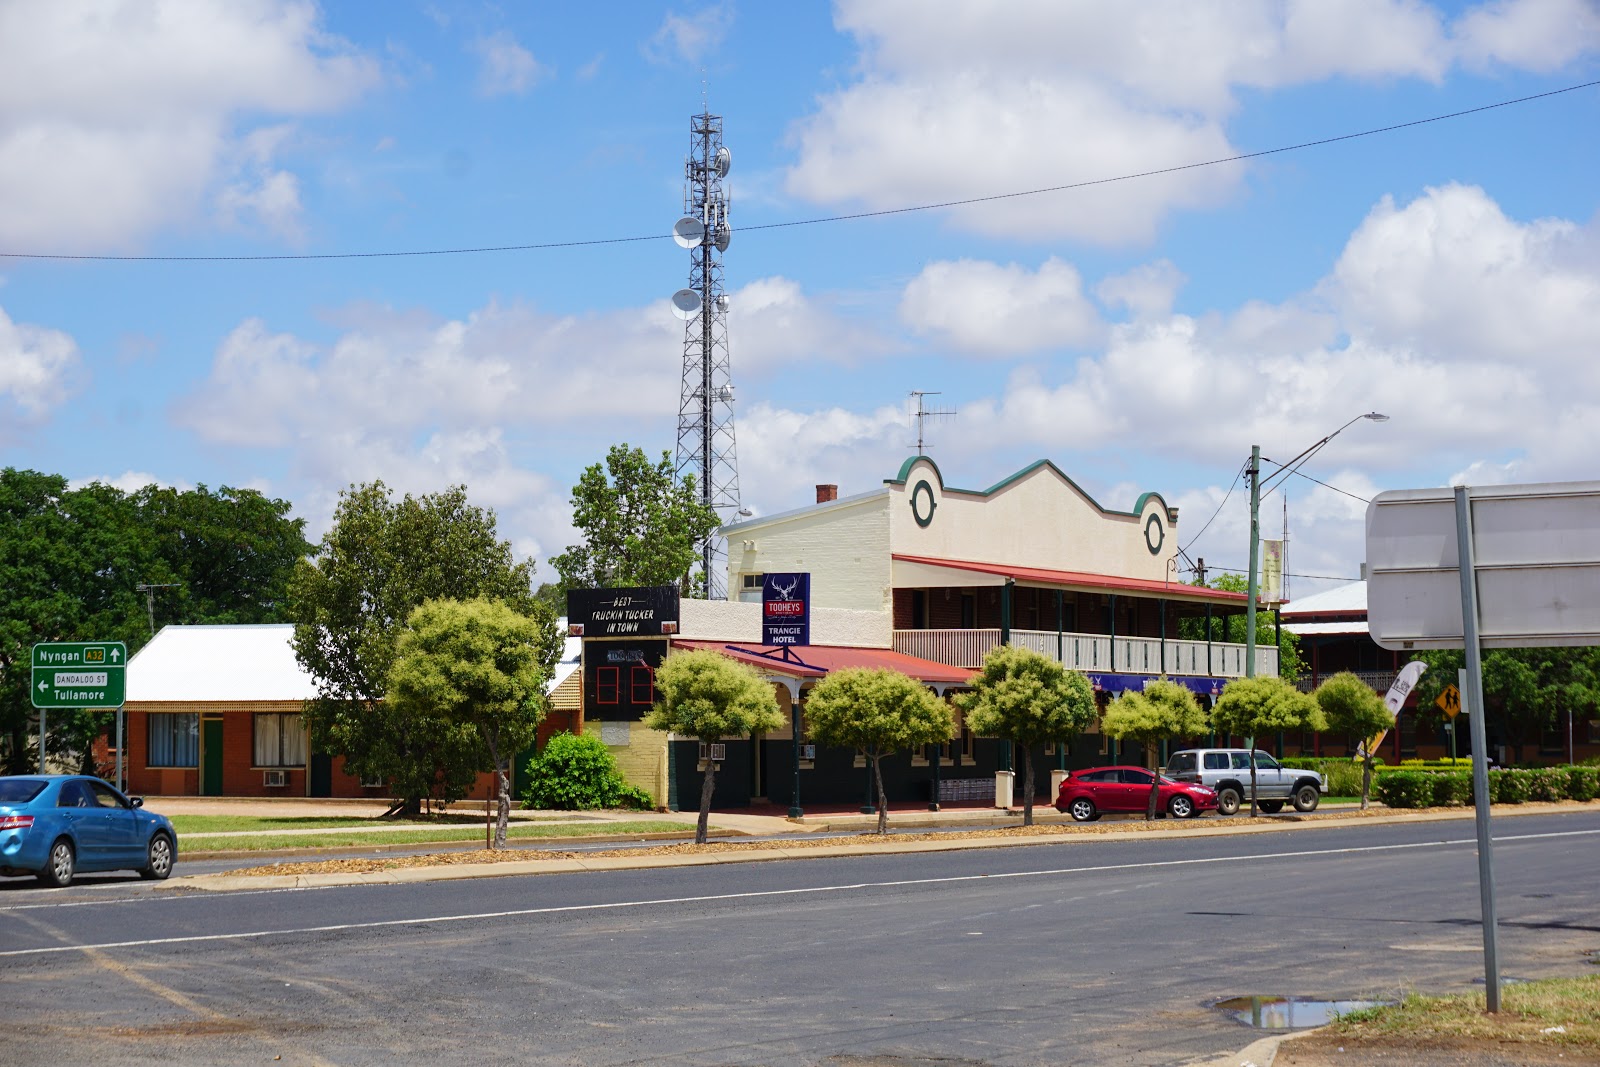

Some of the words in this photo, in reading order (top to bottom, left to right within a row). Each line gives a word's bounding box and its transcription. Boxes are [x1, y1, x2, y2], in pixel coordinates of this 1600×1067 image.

[613, 596, 632, 607] BEST
[769, 603, 800, 611] TOOHEYS
[592, 610, 623, 620] TRUCKIN
[625, 609, 654, 620] TUCKER
[606, 623, 616, 633] IN
[617, 622, 639, 632] TOWN
[40, 650, 80, 664] Nyngan
[86, 650, 103, 661] A32
[97, 675, 105, 683] ST
[54, 689, 105, 700] Tullamore
